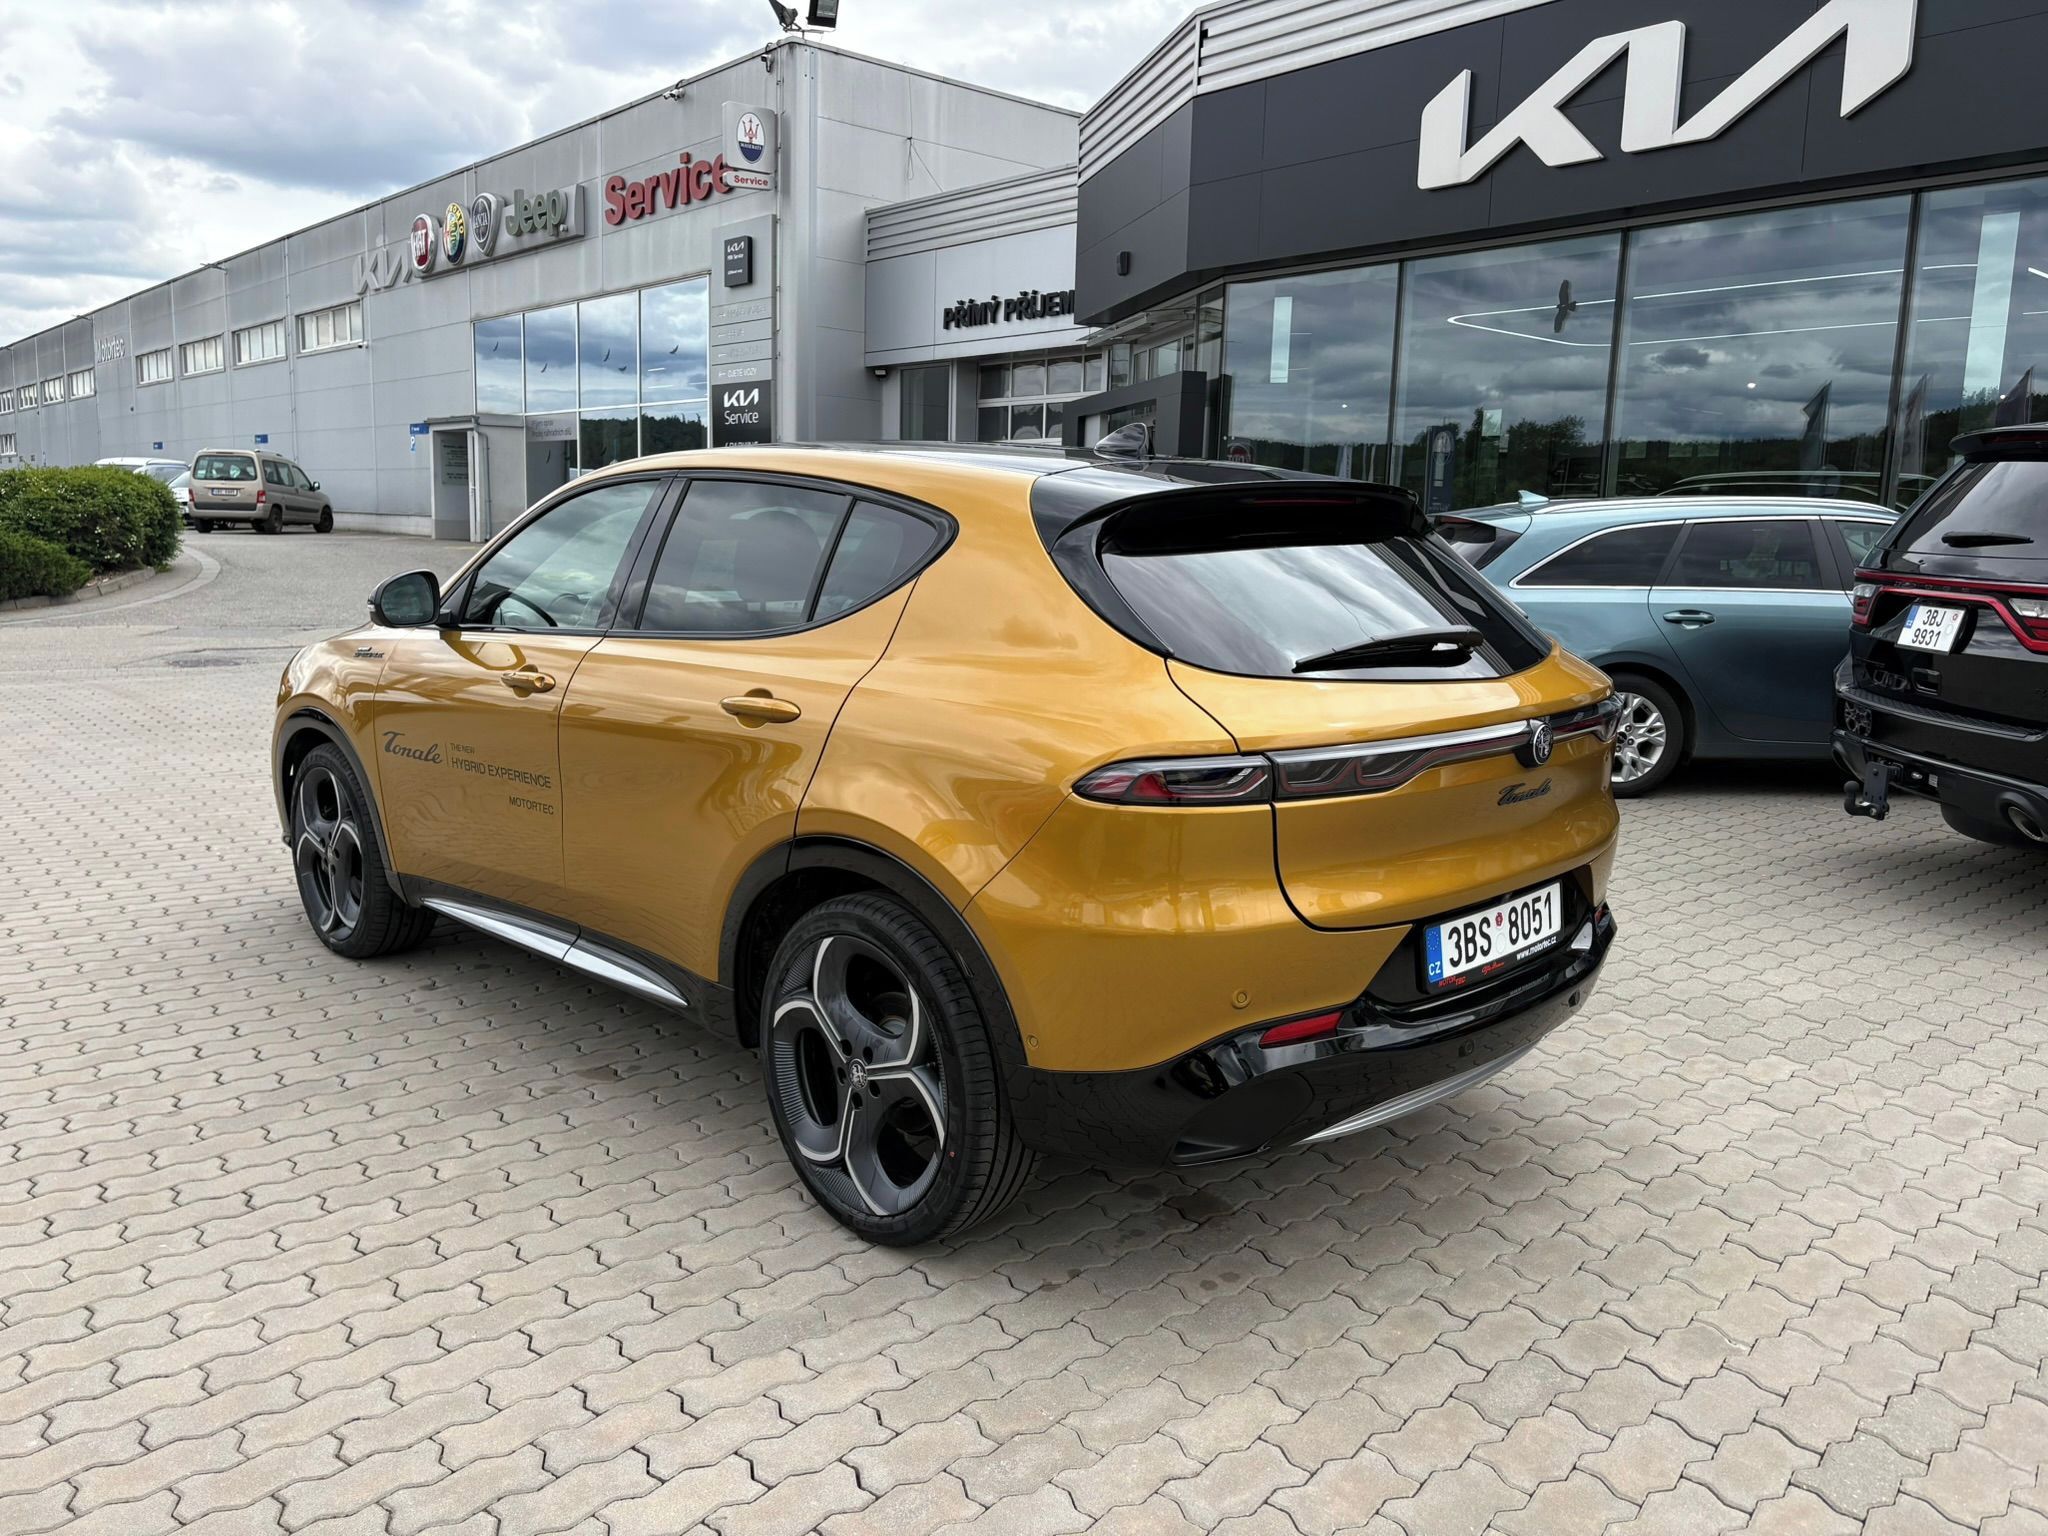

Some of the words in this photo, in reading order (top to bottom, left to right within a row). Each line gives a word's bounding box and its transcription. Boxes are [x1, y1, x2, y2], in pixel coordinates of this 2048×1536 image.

[1417, 0, 1916, 190] KIA
[605, 152, 733, 225] Service
[734, 175, 769, 187] Service
[412, 228, 427, 257] FIAT
[727, 241, 745, 253] KIA
[352, 243, 413, 295] KIA
[943, 295, 1002, 330] PŘÍMÝ
[1004, 289, 1075, 322] PŘÍJEM
[723, 388, 760, 408] KIA
[724, 409, 759, 425] Service
[1922, 608, 1947, 627] 3BJ
[1911, 627, 1942, 647] 9931
[382, 731, 443, 764] Tonale
[451, 757, 486, 775] HYBRID
[487, 764, 552, 789] EXPERIENCE
[509, 796, 554, 815] MOTORTEC
[1448, 916, 1492, 968] 3BS
[1508, 891, 1552, 945] 8051
[1516, 936, 1557, 960] www.motortec.cz
[1428, 961, 1441, 976] CZ
